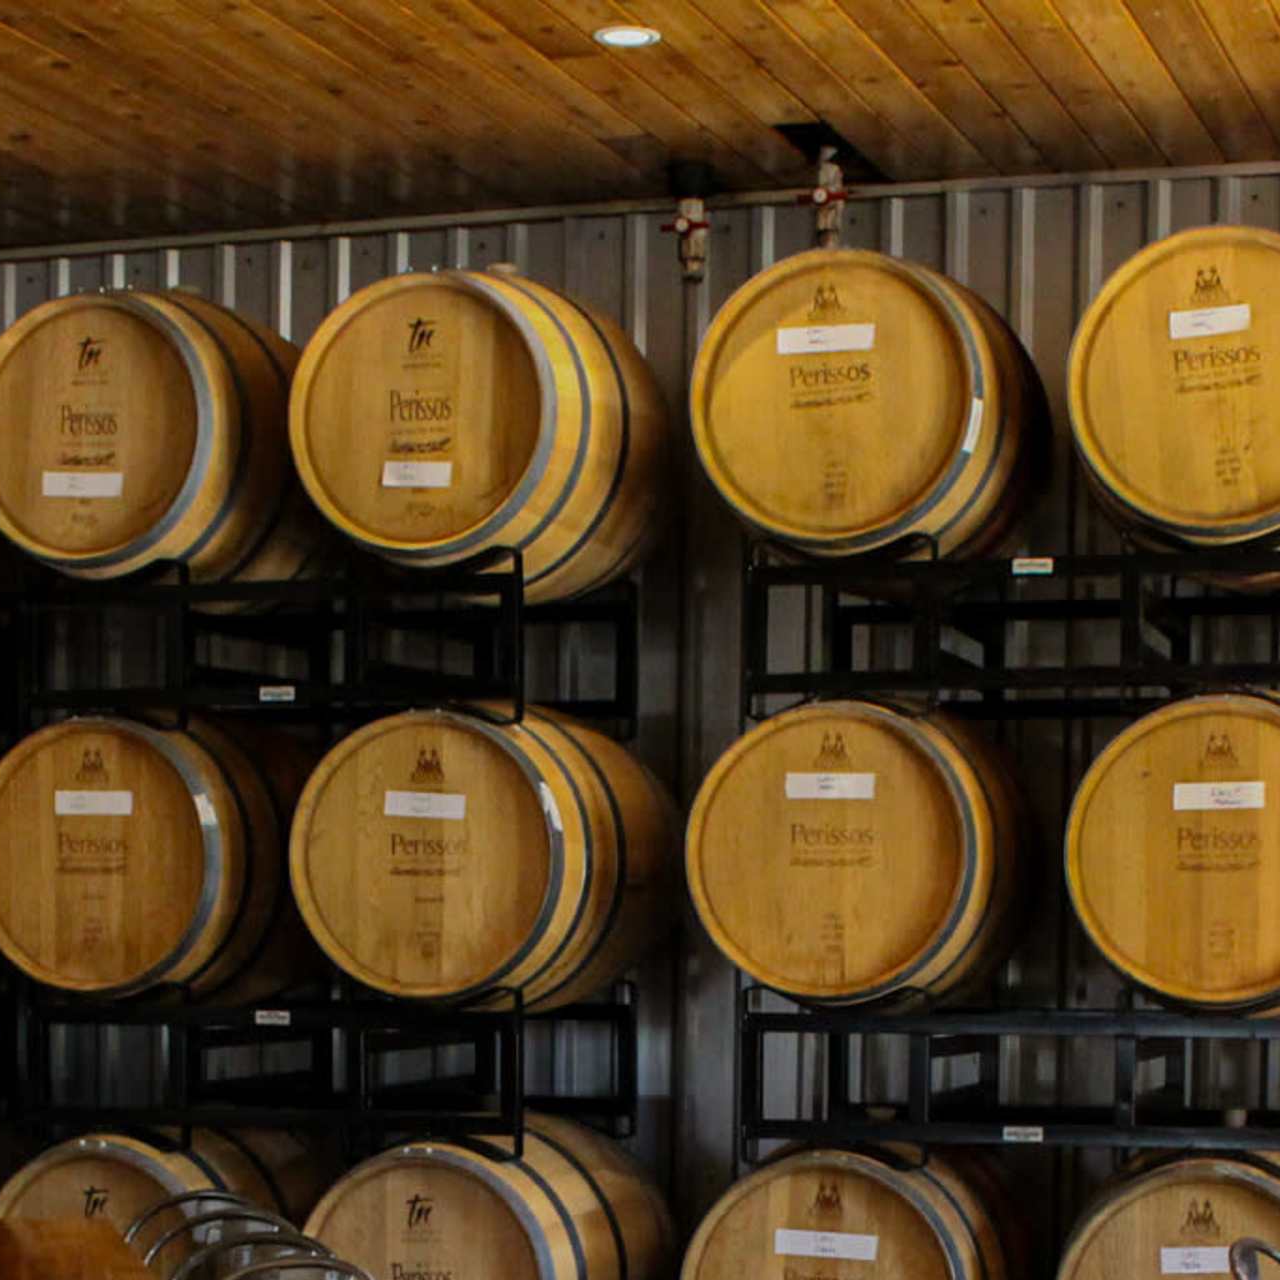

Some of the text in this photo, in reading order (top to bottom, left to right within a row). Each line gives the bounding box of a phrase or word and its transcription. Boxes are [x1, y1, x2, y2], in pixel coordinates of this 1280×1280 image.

[1173, 345, 1261, 372] Perissos
[789, 363, 871, 388] Perissos
[389, 389, 453, 422] Perissos
[59, 405, 117, 437] Perissos
[57, 833, 128, 857] Perissos
[390, 833, 466, 858] Perissos
[790, 823, 874, 846] Perissos
